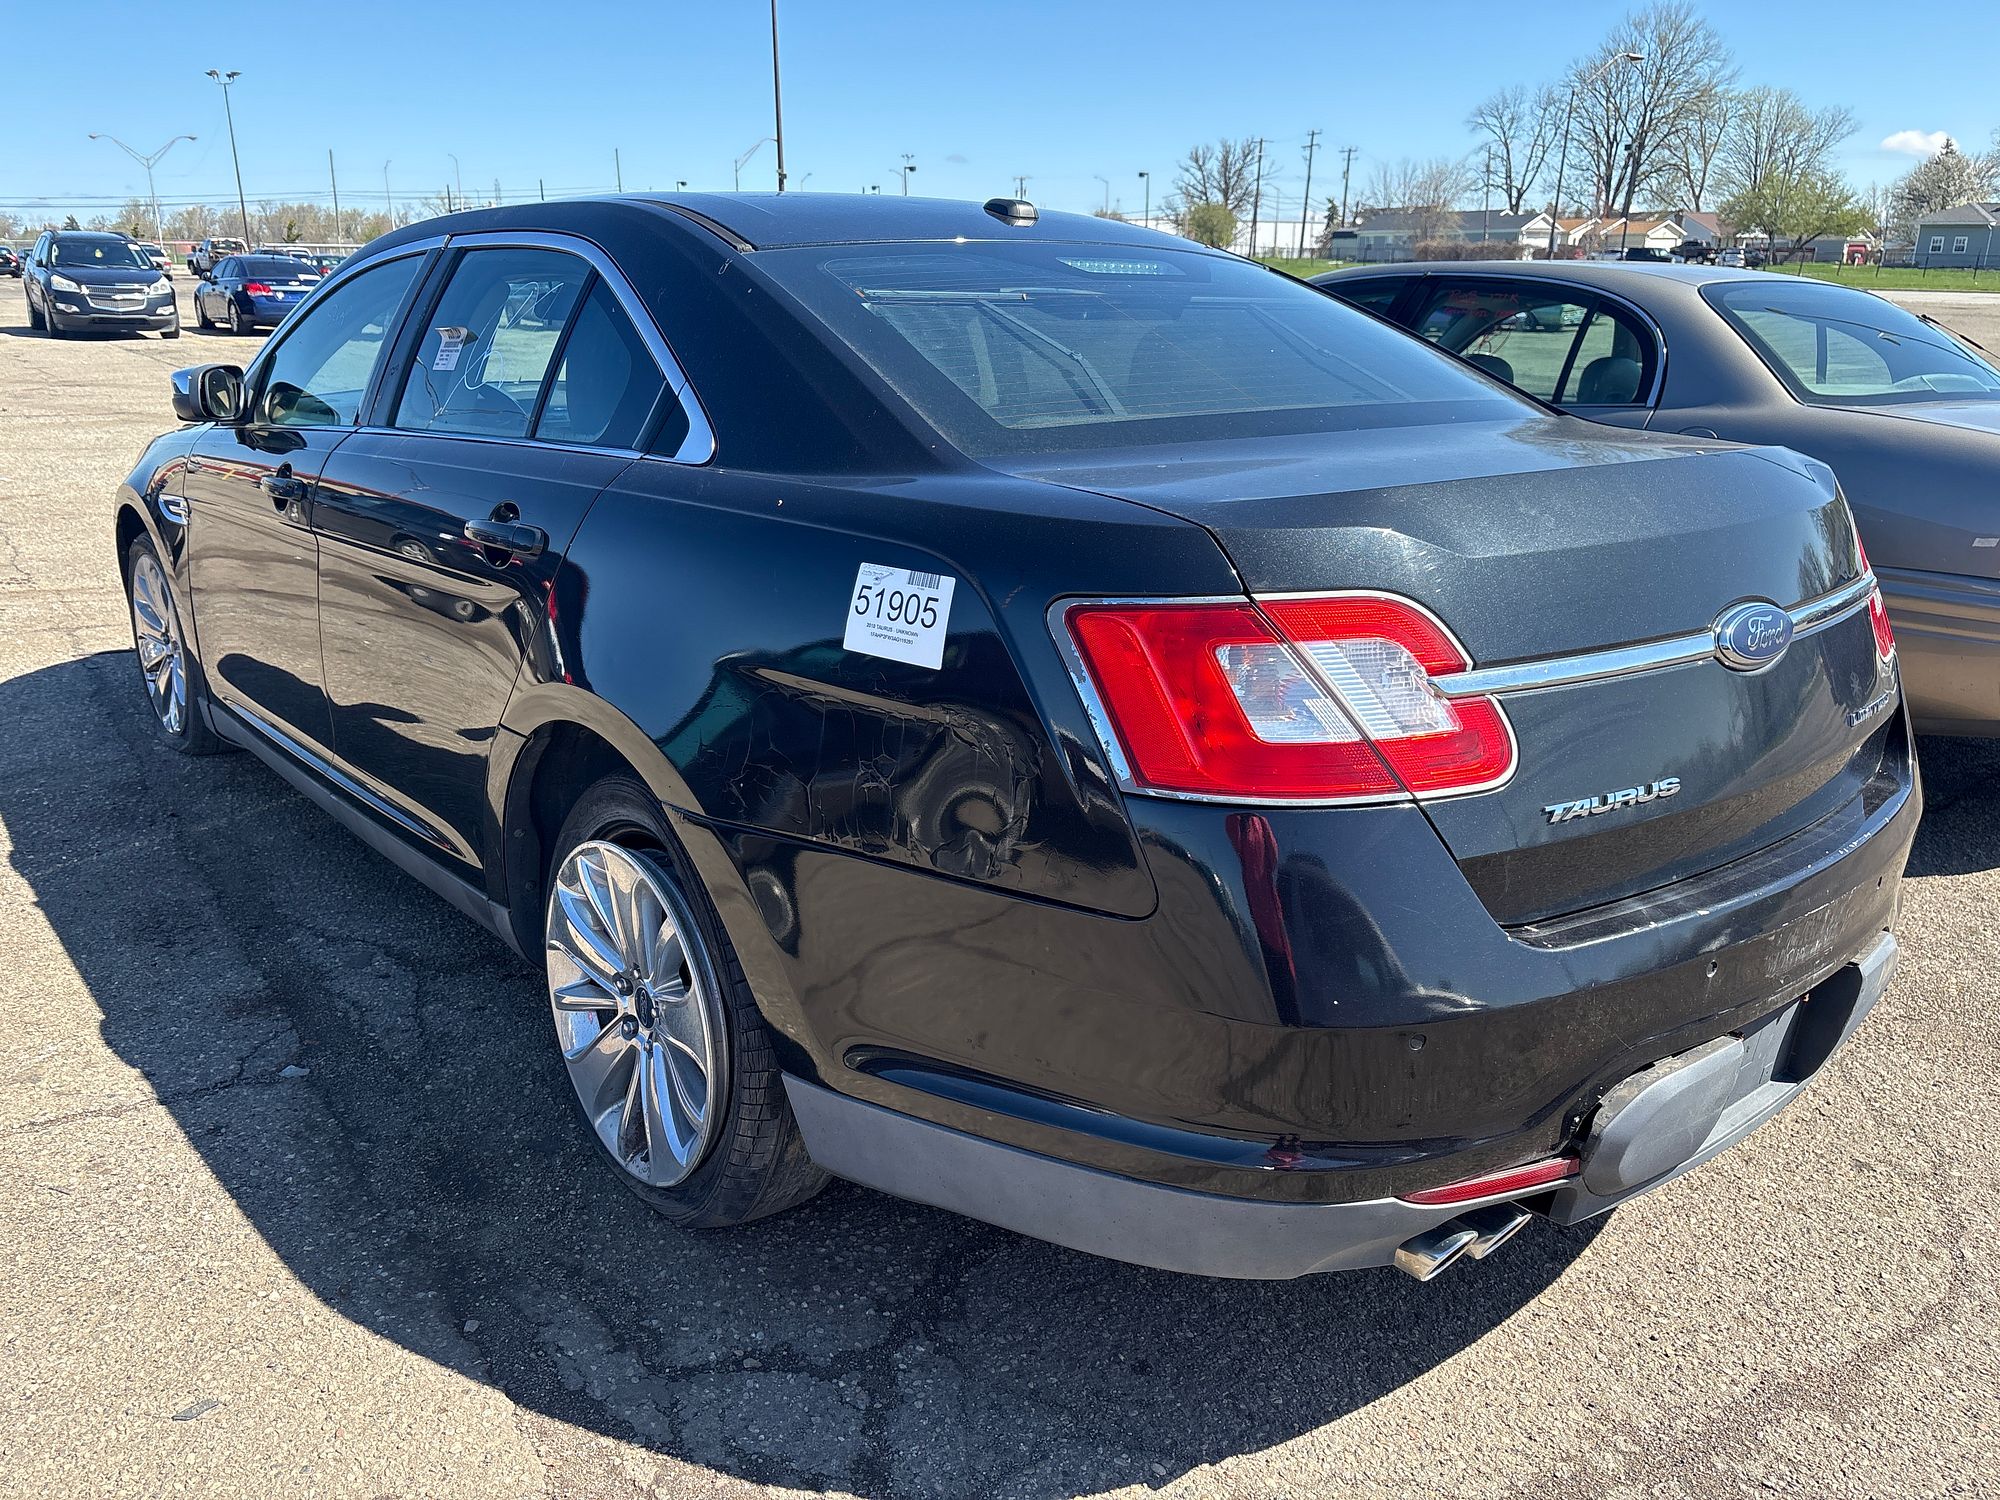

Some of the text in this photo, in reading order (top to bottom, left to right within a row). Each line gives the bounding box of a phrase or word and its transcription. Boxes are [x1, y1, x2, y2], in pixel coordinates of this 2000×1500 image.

[855, 585, 939, 629] 51905
[1748, 615, 1785, 651] Ford
[1543, 777, 1681, 823] TAURUS
